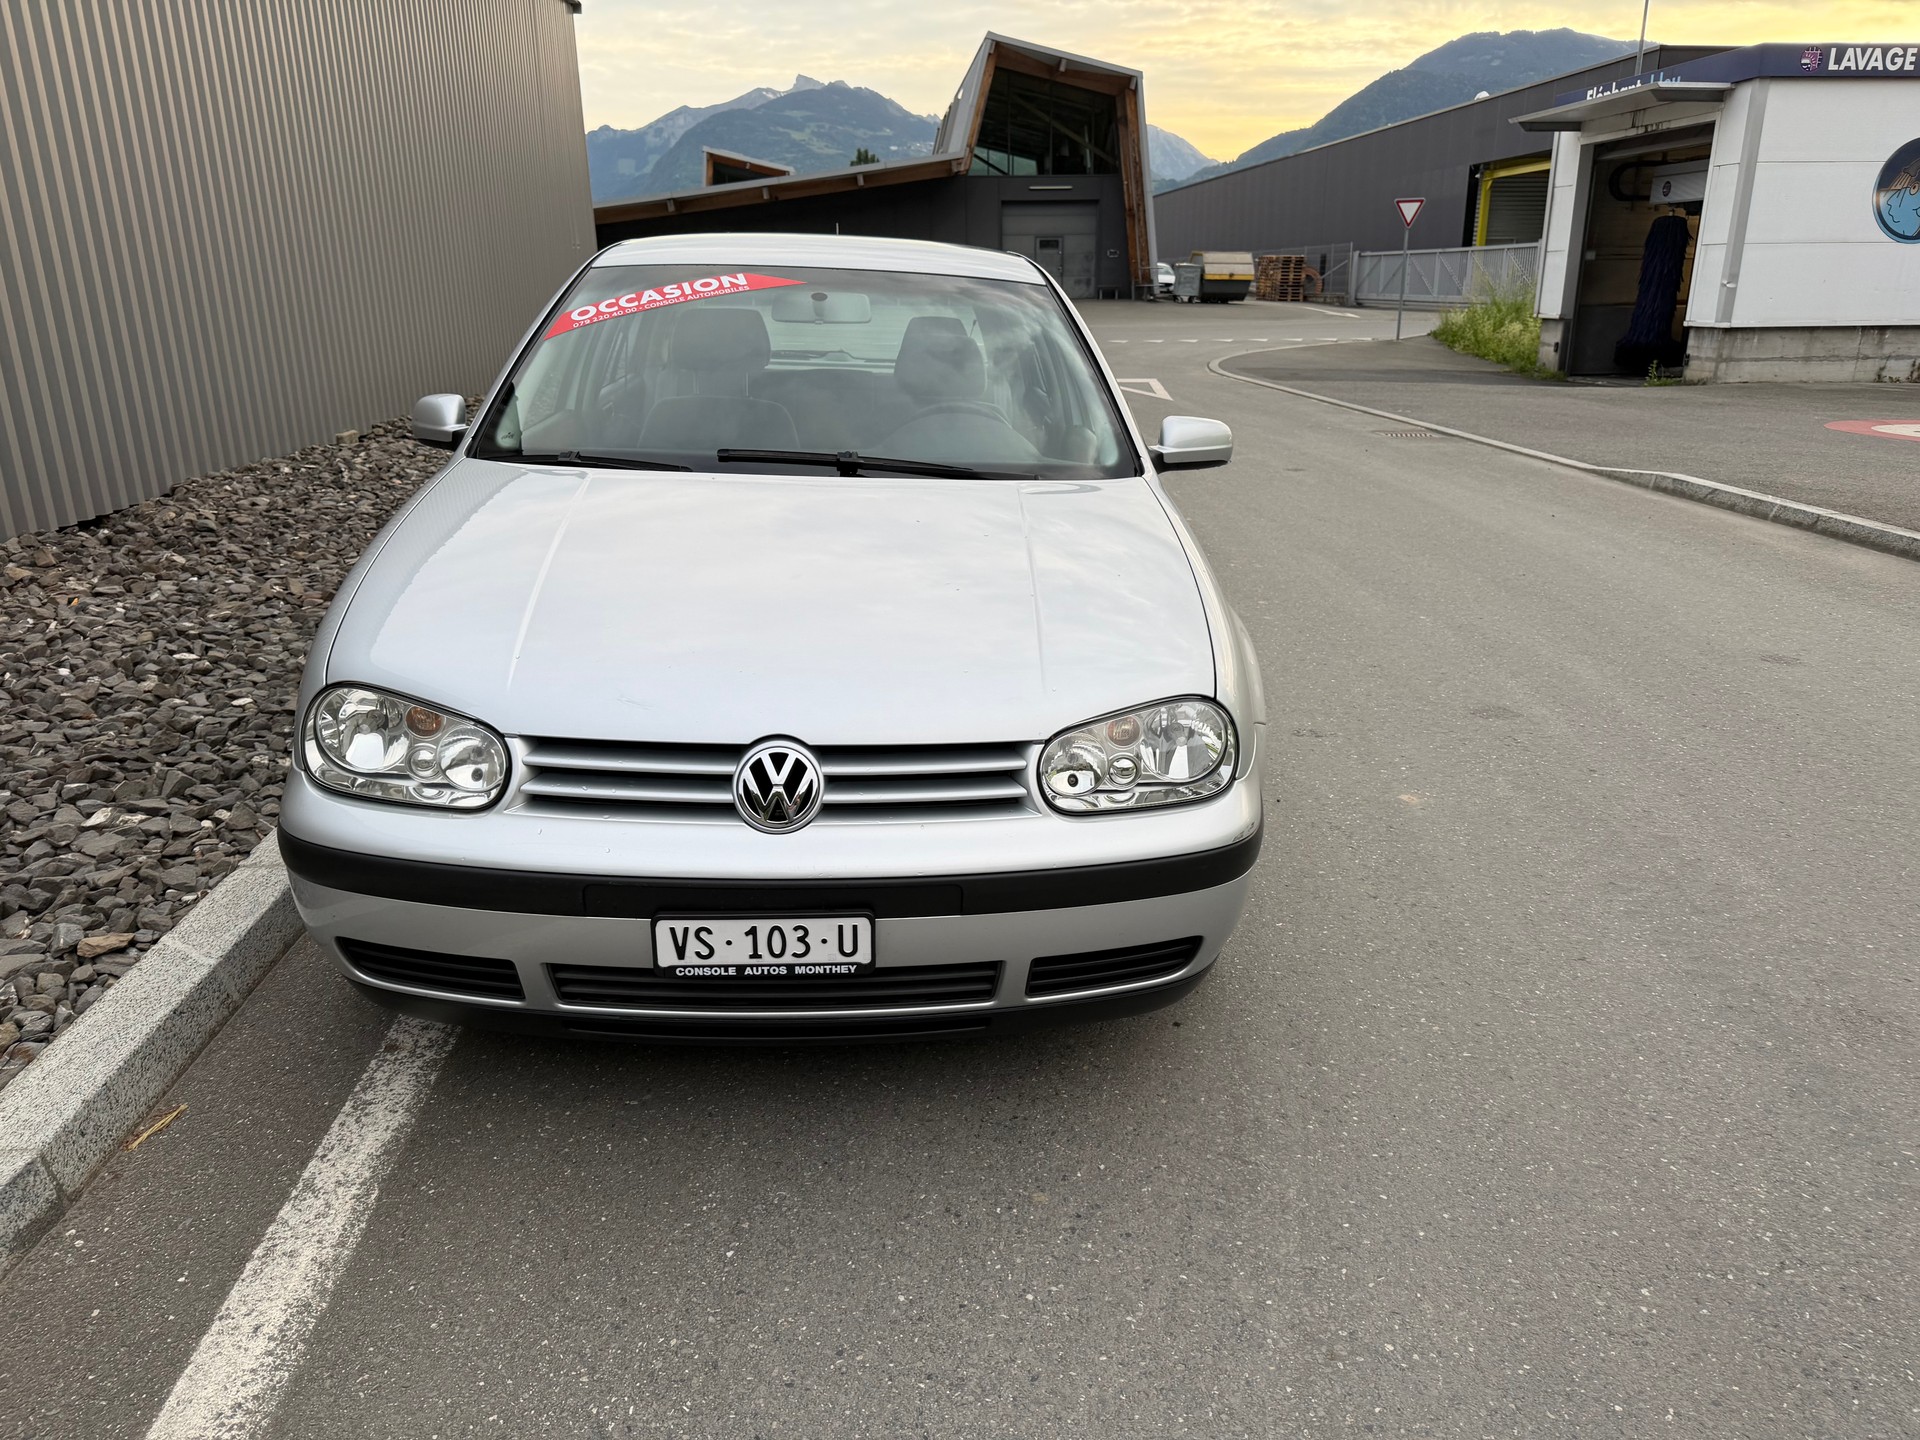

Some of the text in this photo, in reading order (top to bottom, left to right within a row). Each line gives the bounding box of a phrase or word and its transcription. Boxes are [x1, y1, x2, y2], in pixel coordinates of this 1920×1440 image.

[1827, 47, 1918, 71] LAVAGE
[570, 273, 748, 321] OCCASION
[573, 319, 591, 328] 079
[611, 310, 624, 318] 40
[625, 306, 637, 314] 00
[644, 296, 686, 309] CONSOLE
[687, 285, 750, 300] AUTOMOBILES
[675, 964, 858, 976] CONSOLE AUTOS MONTHEY
